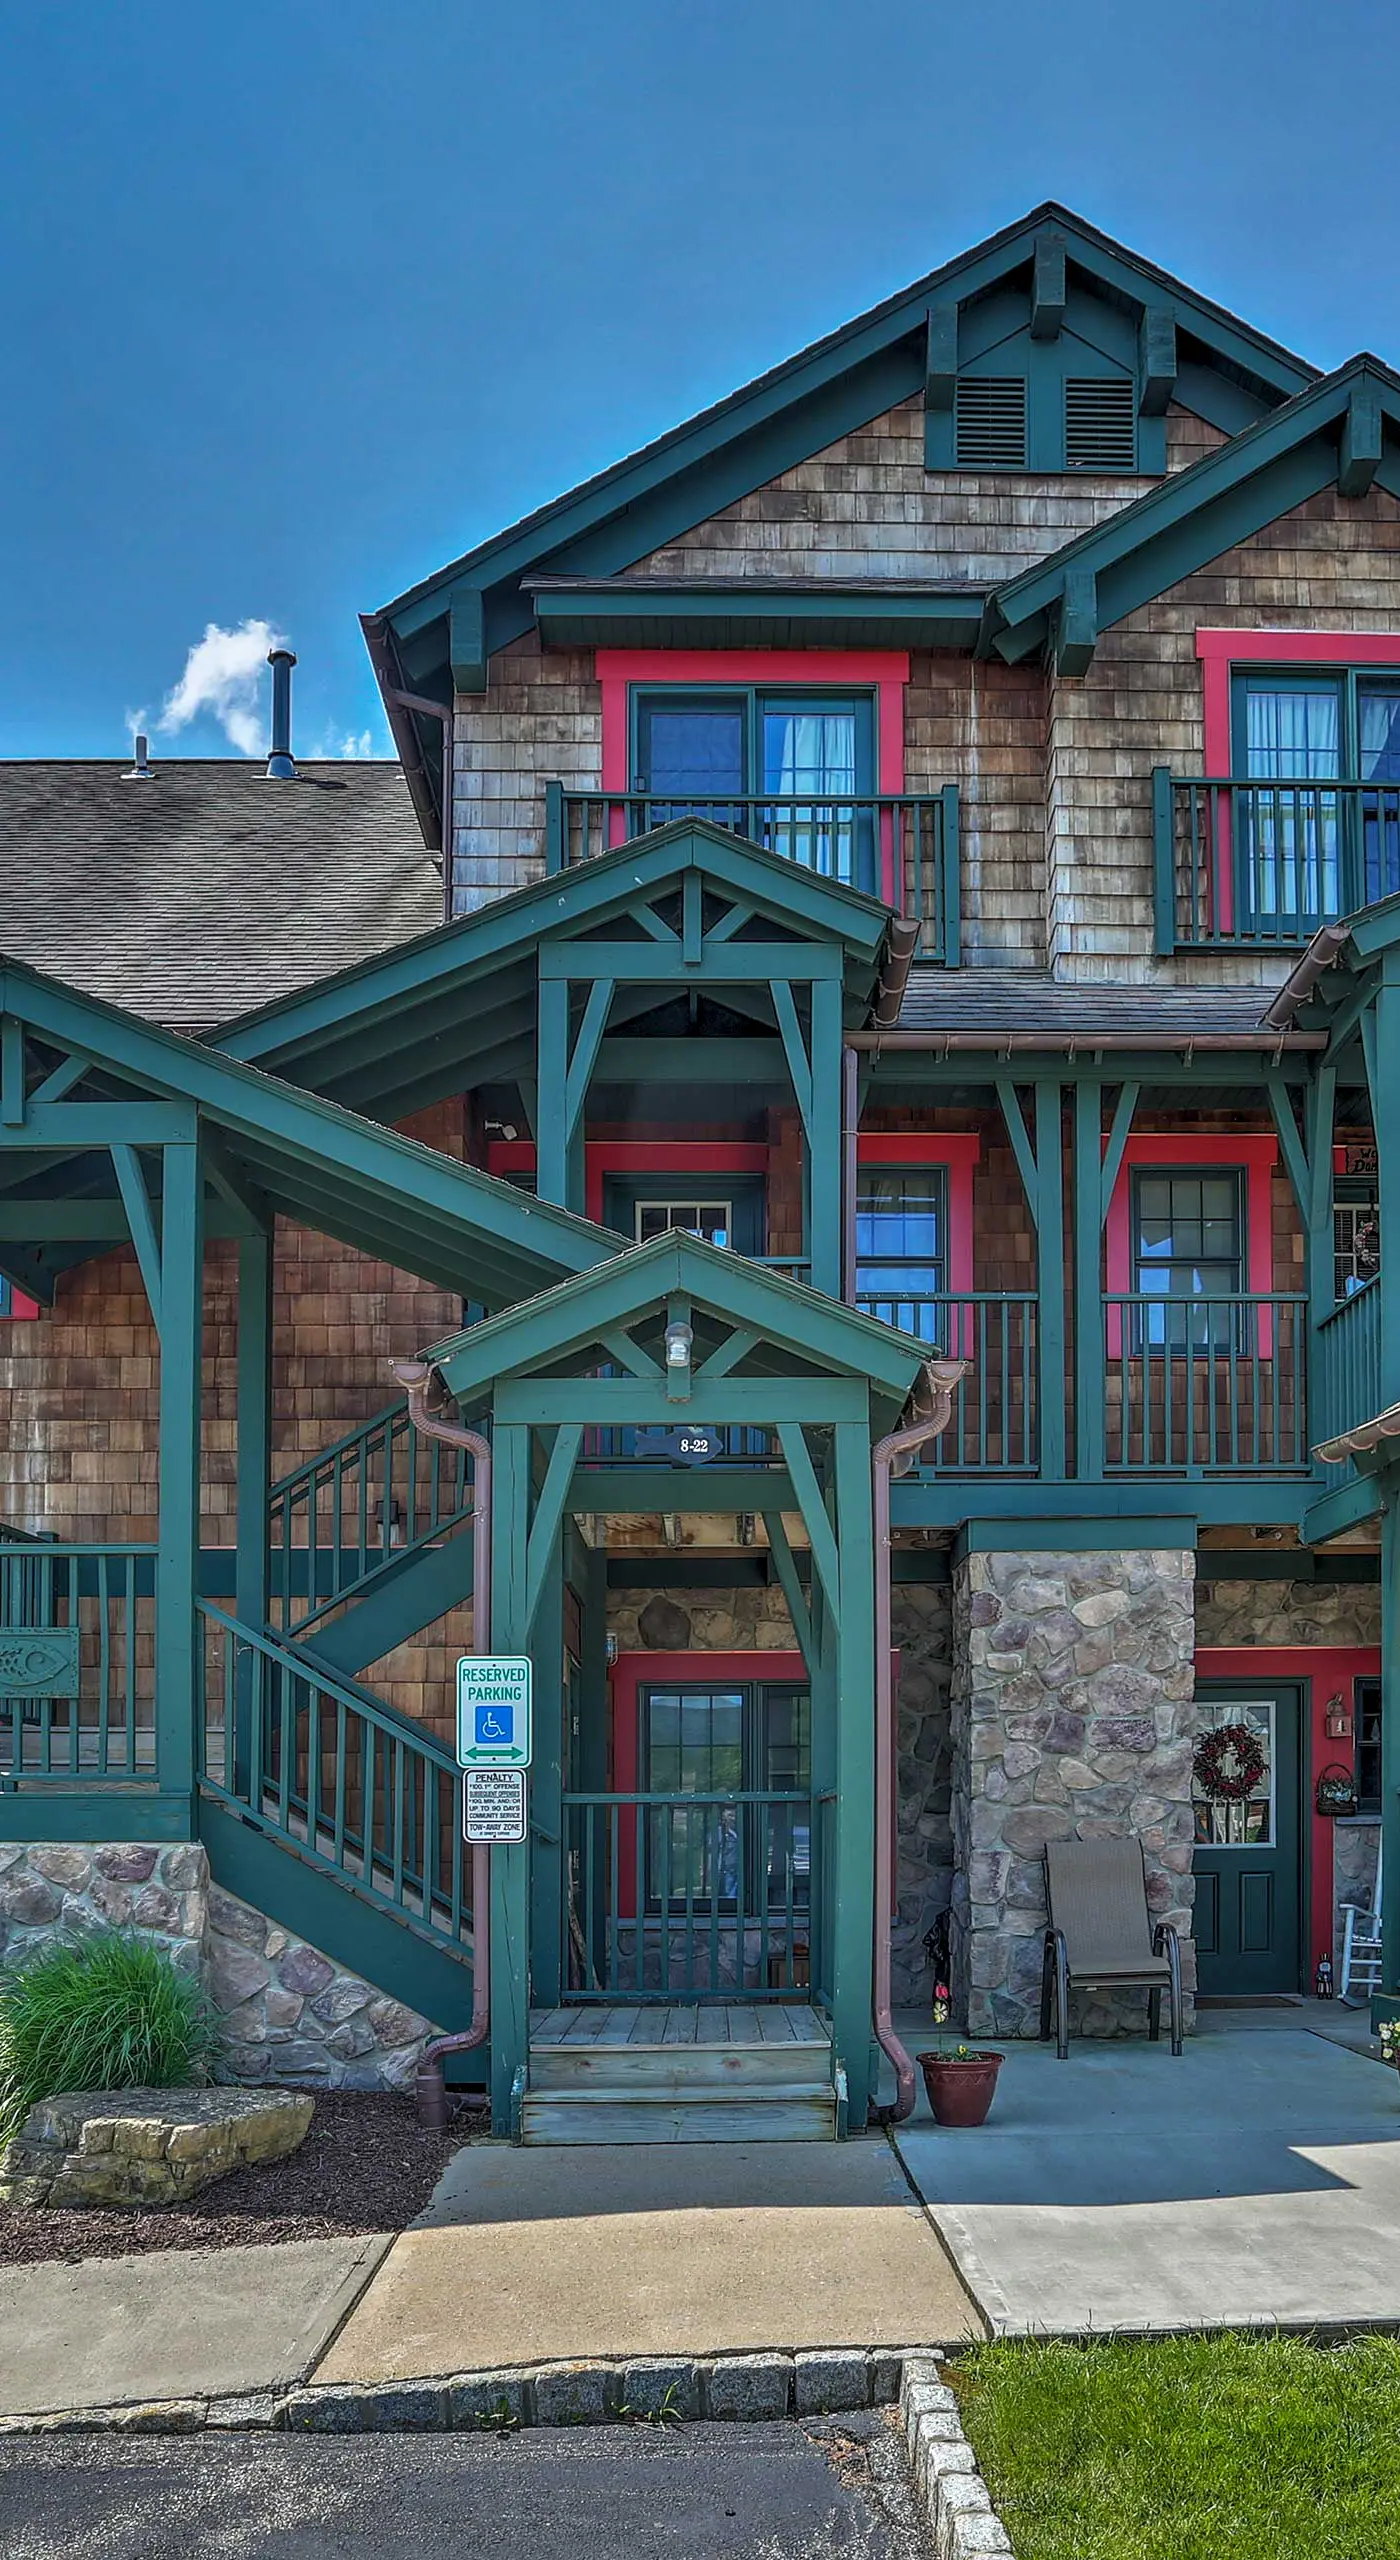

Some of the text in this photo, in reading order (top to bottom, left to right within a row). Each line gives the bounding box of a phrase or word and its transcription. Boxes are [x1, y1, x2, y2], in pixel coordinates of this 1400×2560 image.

[680, 1438, 708, 1453] 8-22
[462, 1668, 526, 1682] RESERVED
[468, 1686, 522, 1701] PARKING
[469, 1823, 521, 1831] TOW-AWAY ZONE
